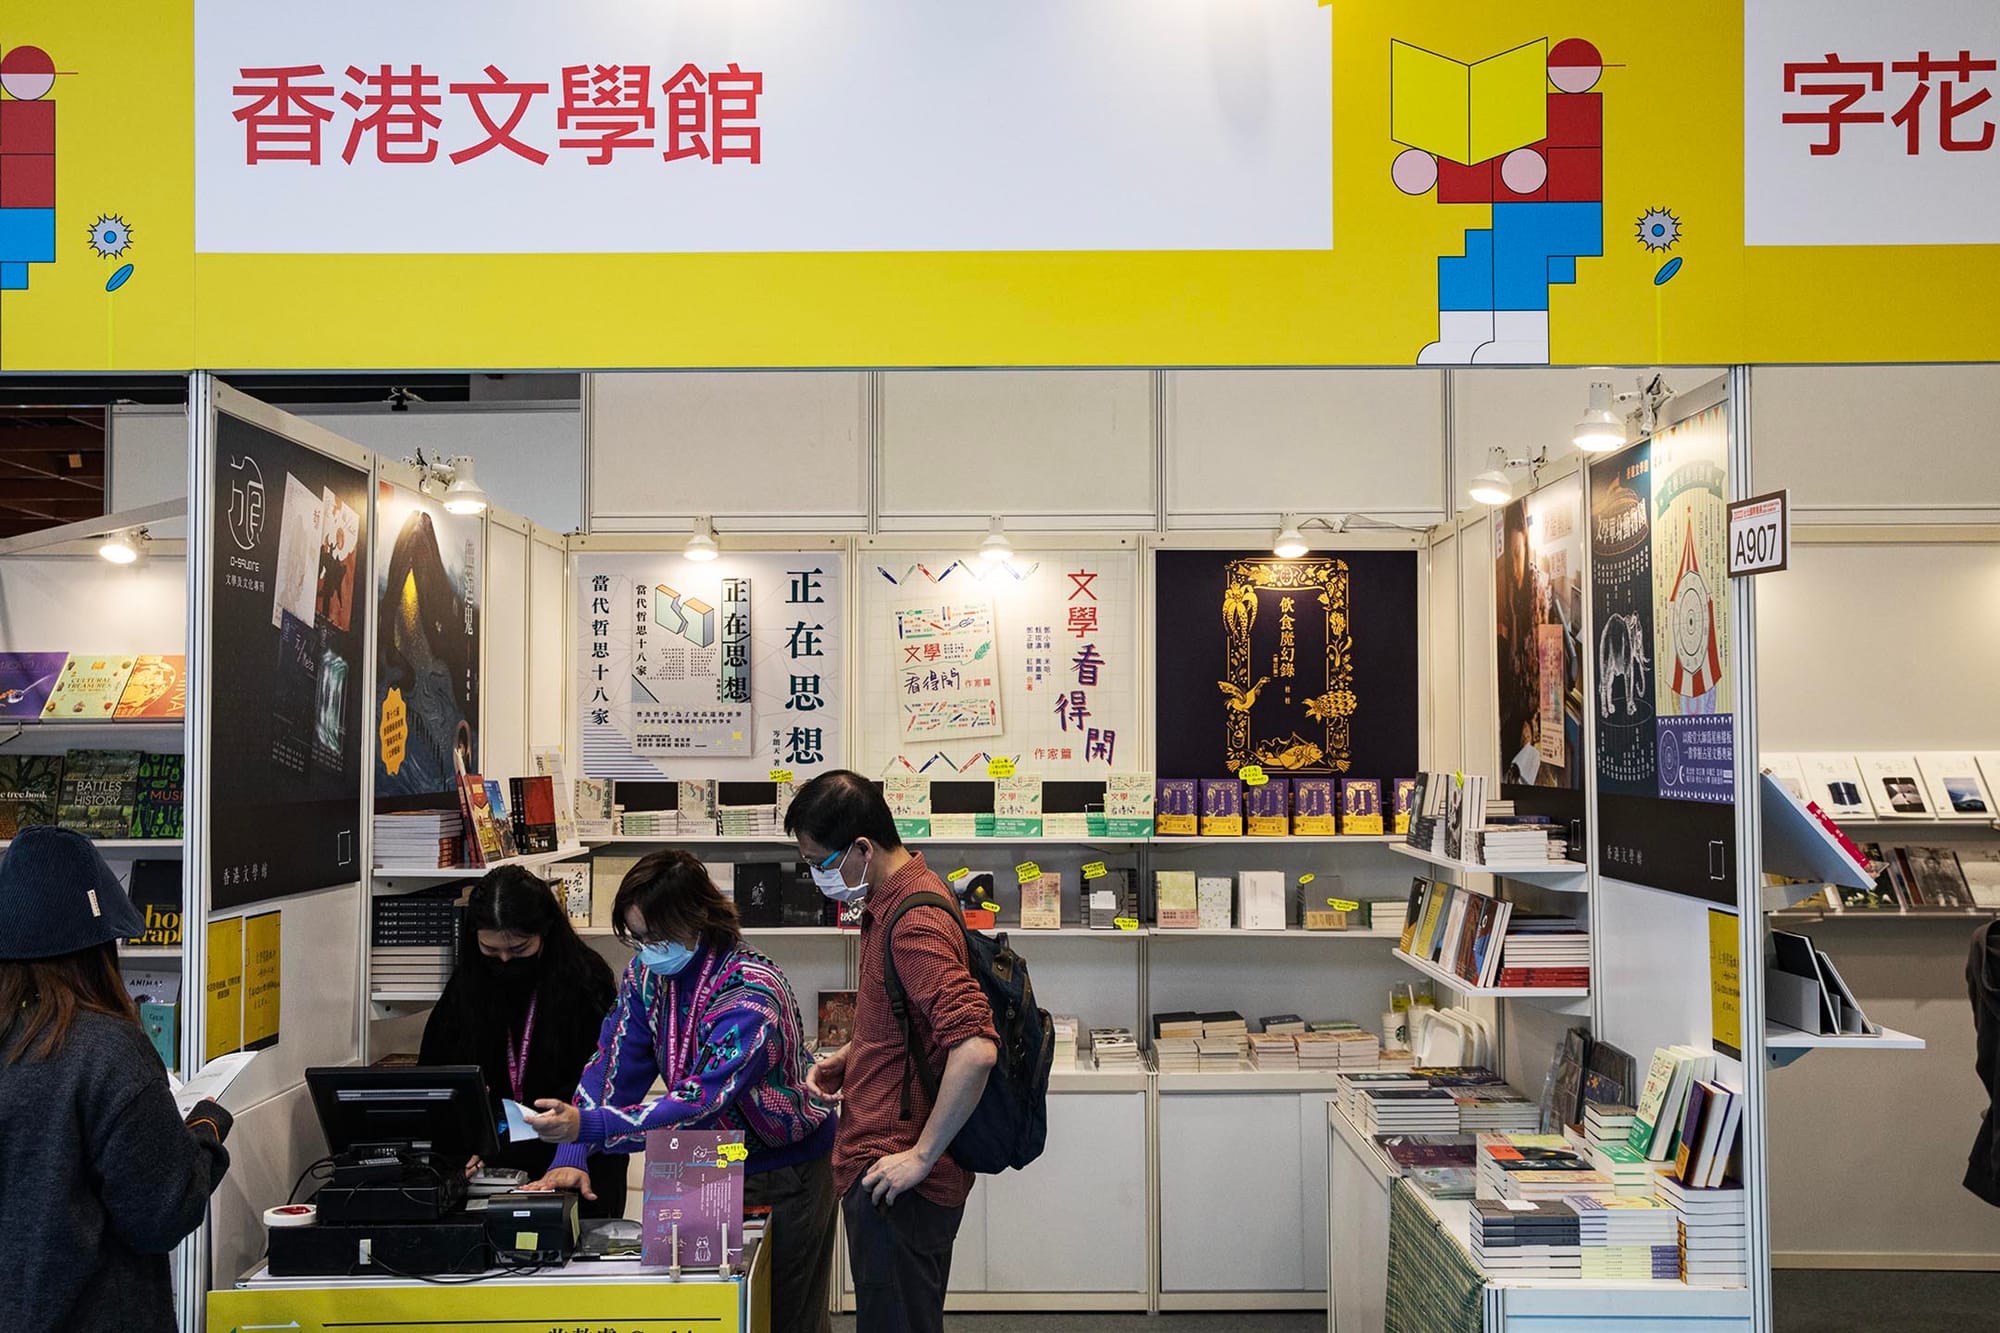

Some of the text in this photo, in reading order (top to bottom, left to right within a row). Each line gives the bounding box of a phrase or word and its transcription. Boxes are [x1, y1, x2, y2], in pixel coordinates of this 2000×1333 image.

[231, 62, 764, 167] 香港文學館
[1782, 51, 1997, 156] 字花
[1735, 524, 1777, 566] A907
[591, 575, 609, 726] 當代哲思十八家
[635, 584, 648, 677] 當代哲思十八家
[723, 580, 748, 700] 正在思想
[784, 568, 825, 765] 正在思想
[903, 643, 942, 663] 文學
[1279, 597, 1296, 678] 飲食魔幻錄
[903, 668, 961, 694] 看得開
[76, 781, 122, 792] BATTLES
[1033, 748, 1073, 760] 作家篇
[74, 794, 121, 806] HISTORY
